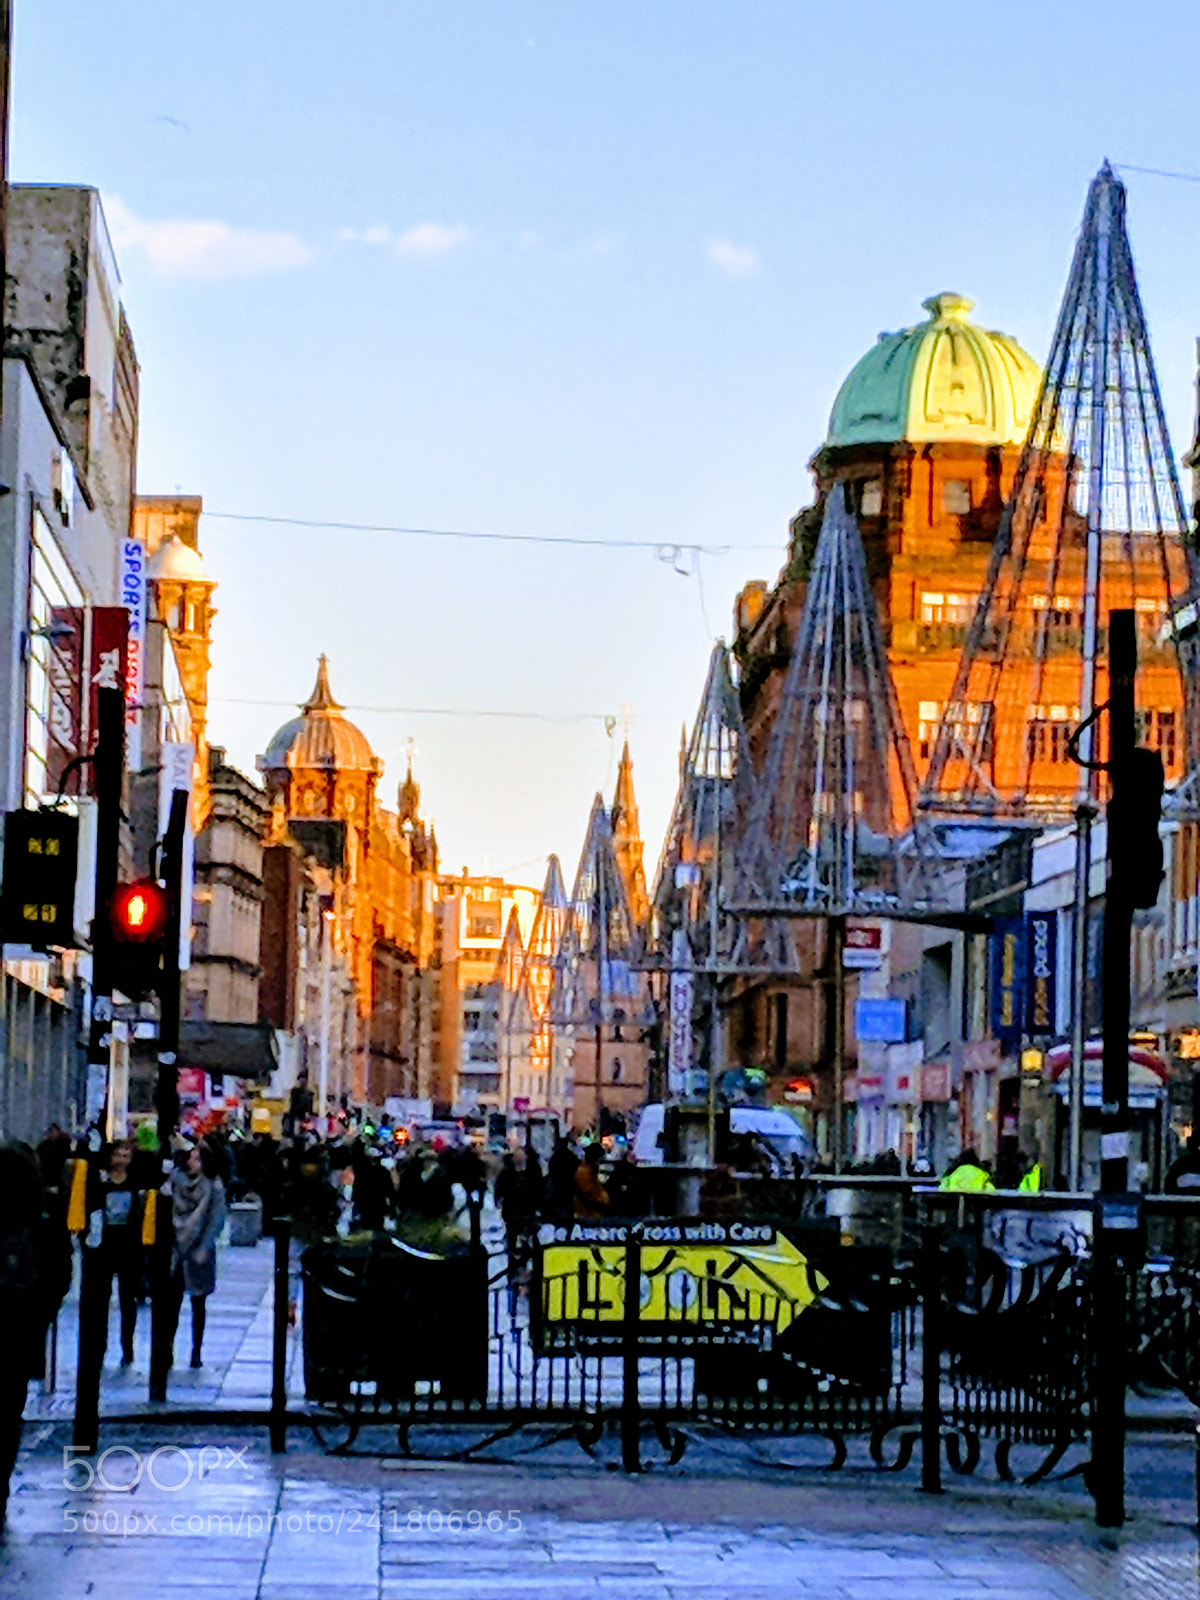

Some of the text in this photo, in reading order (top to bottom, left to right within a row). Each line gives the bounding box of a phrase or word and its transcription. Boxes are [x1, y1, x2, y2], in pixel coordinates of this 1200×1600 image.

[537, 1223, 568, 1244] e
[570, 1224, 627, 1241] Aware
[684, 1222, 726, 1241] with
[729, 1222, 772, 1241] Care
